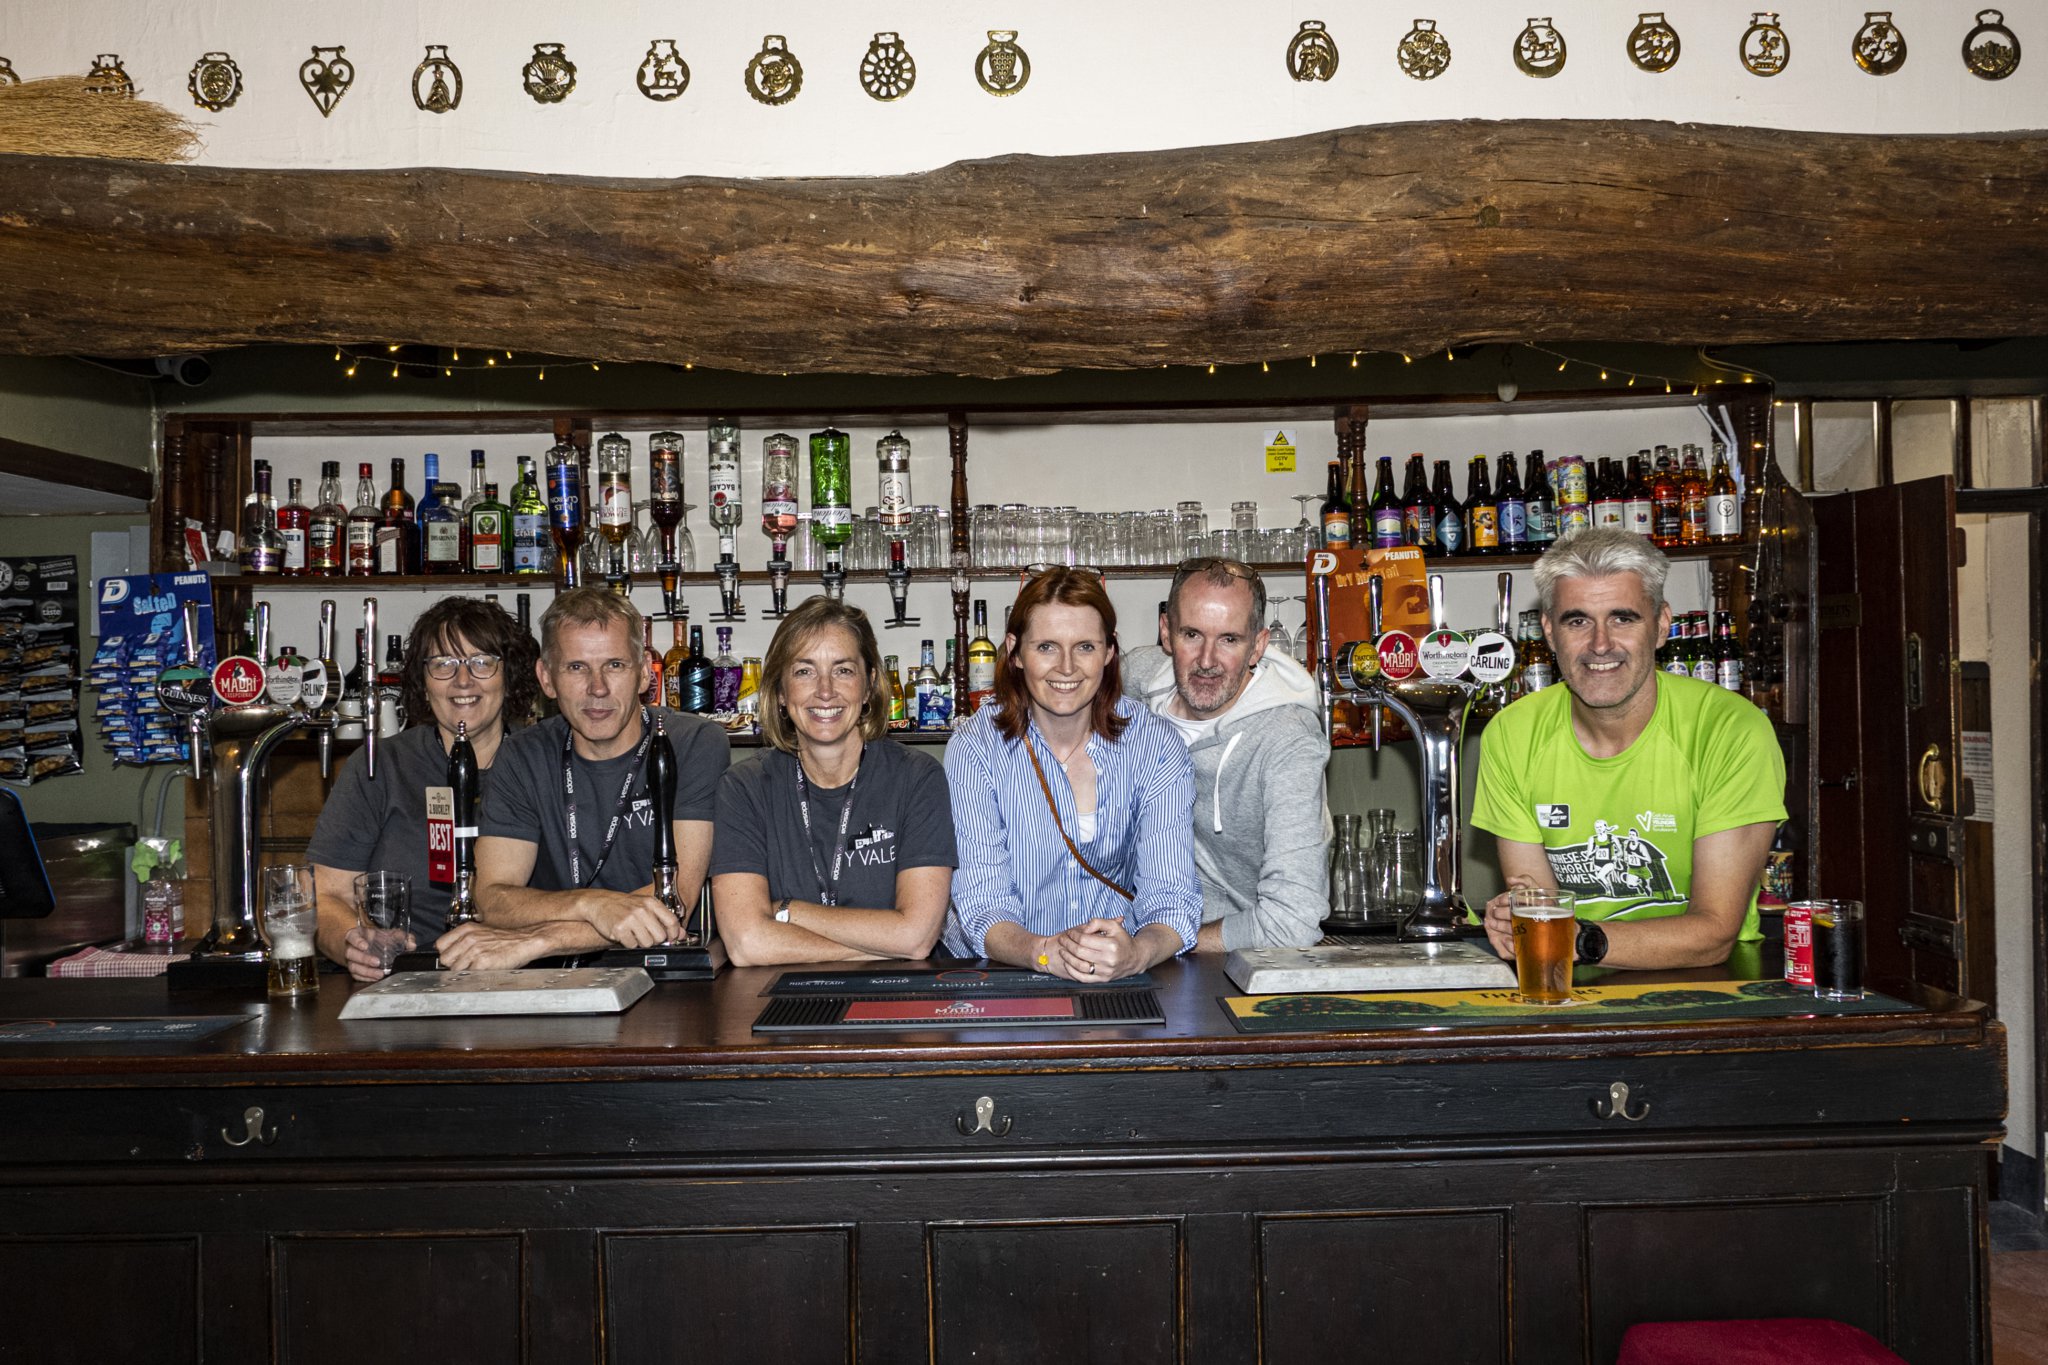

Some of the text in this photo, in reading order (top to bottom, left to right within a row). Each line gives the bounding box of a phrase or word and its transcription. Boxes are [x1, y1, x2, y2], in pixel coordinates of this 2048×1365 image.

[1384, 550, 1420, 561] PEANUTS
[174, 574, 207, 586] PEANUTS
[1470, 655, 1510, 670] CARLING
[161, 687, 209, 704] GUINNESS
[621, 773, 632, 799] vesopa
[569, 811, 577, 839] vesopa
[623, 808, 655, 829] Y VA
[800, 801, 810, 829] vesopa
[841, 807, 850, 835] vesopa
[429, 823, 451, 851] BEST
[606, 816, 619, 842] vesopa
[833, 853, 842, 881] vesopa
[844, 845, 896, 867] Y VALE
[572, 856, 580, 884] vesopa
